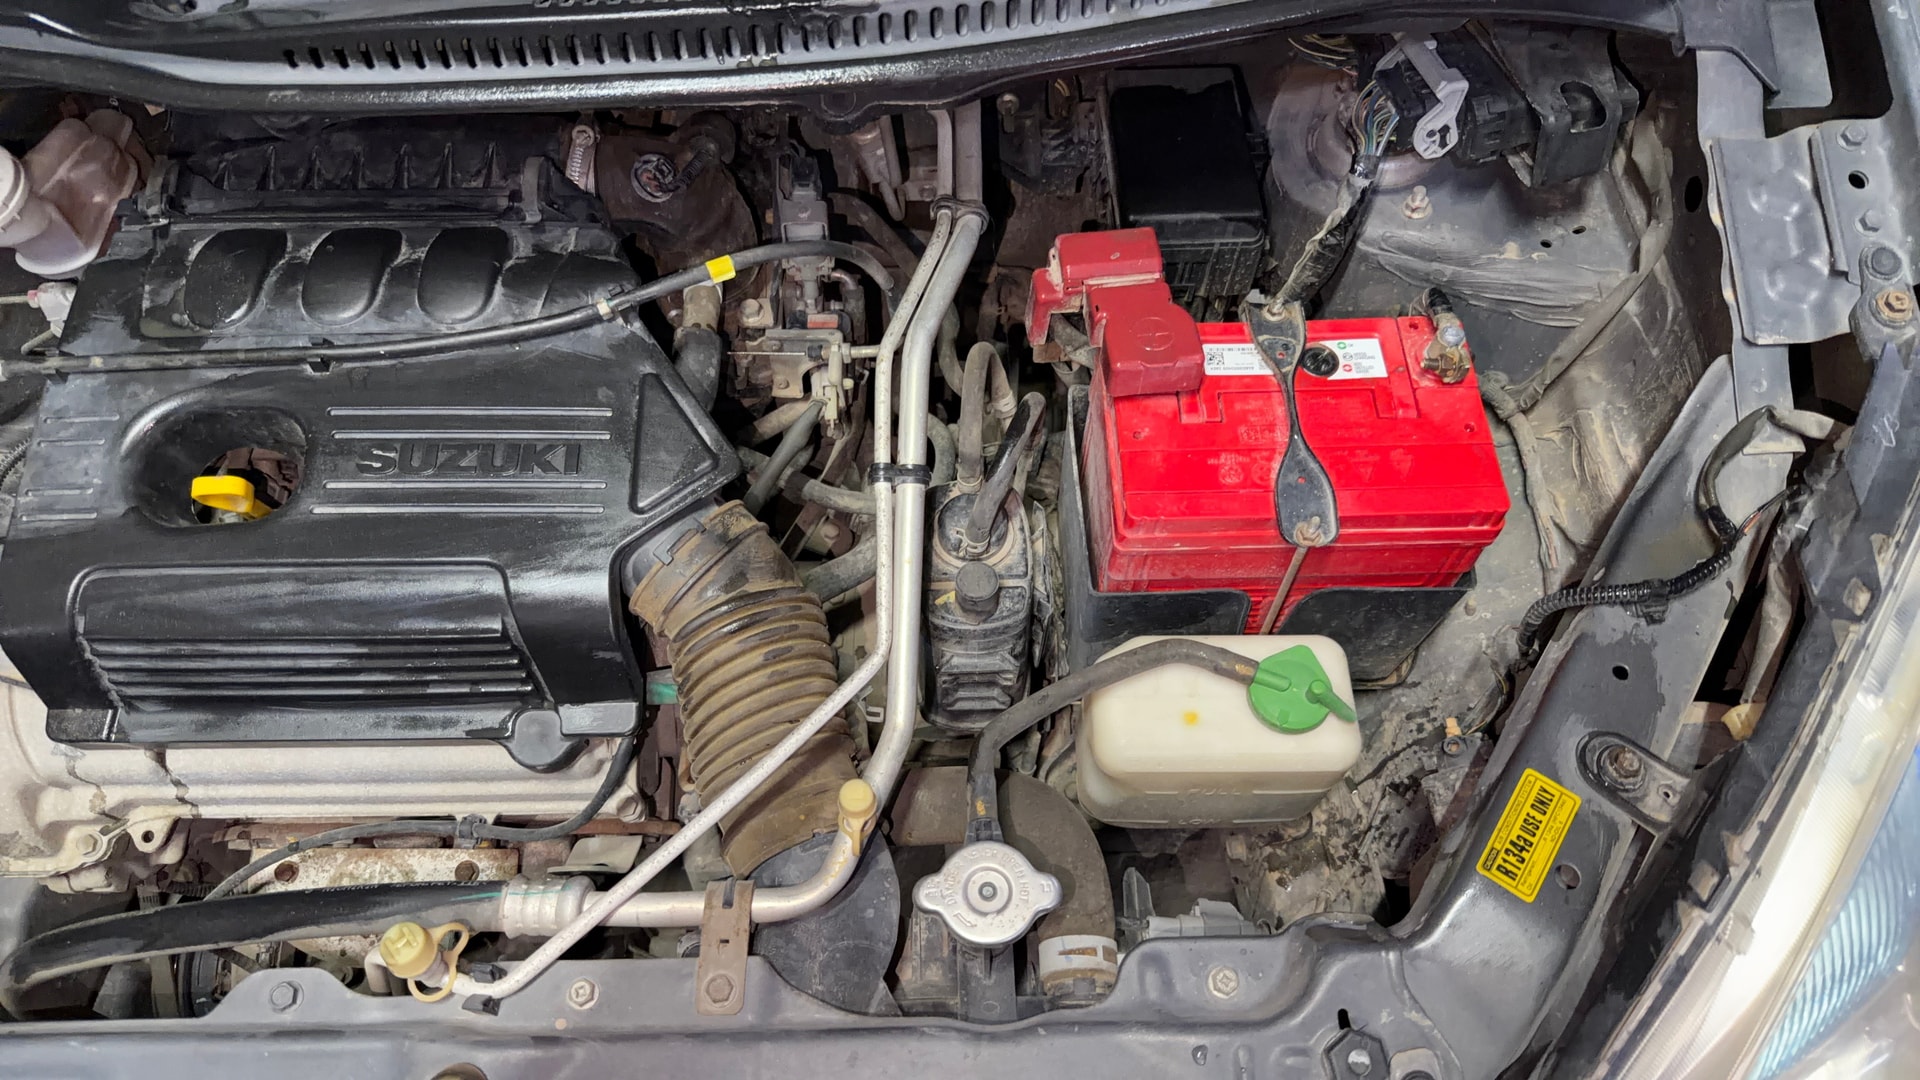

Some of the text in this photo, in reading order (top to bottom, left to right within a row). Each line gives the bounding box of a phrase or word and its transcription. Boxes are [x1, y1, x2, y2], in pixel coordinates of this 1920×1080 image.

[355, 443, 581, 476] SUZUKI
[1186, 787, 1241, 796] FULL
[1177, 818, 1222, 826] LOW
[1495, 785, 1555, 881] R134a USE ONLY
[1484, 848, 1498, 870] CAUTION
[1001, 852, 1026, 879] OPEN
[1019, 881, 1030, 903] HOT
